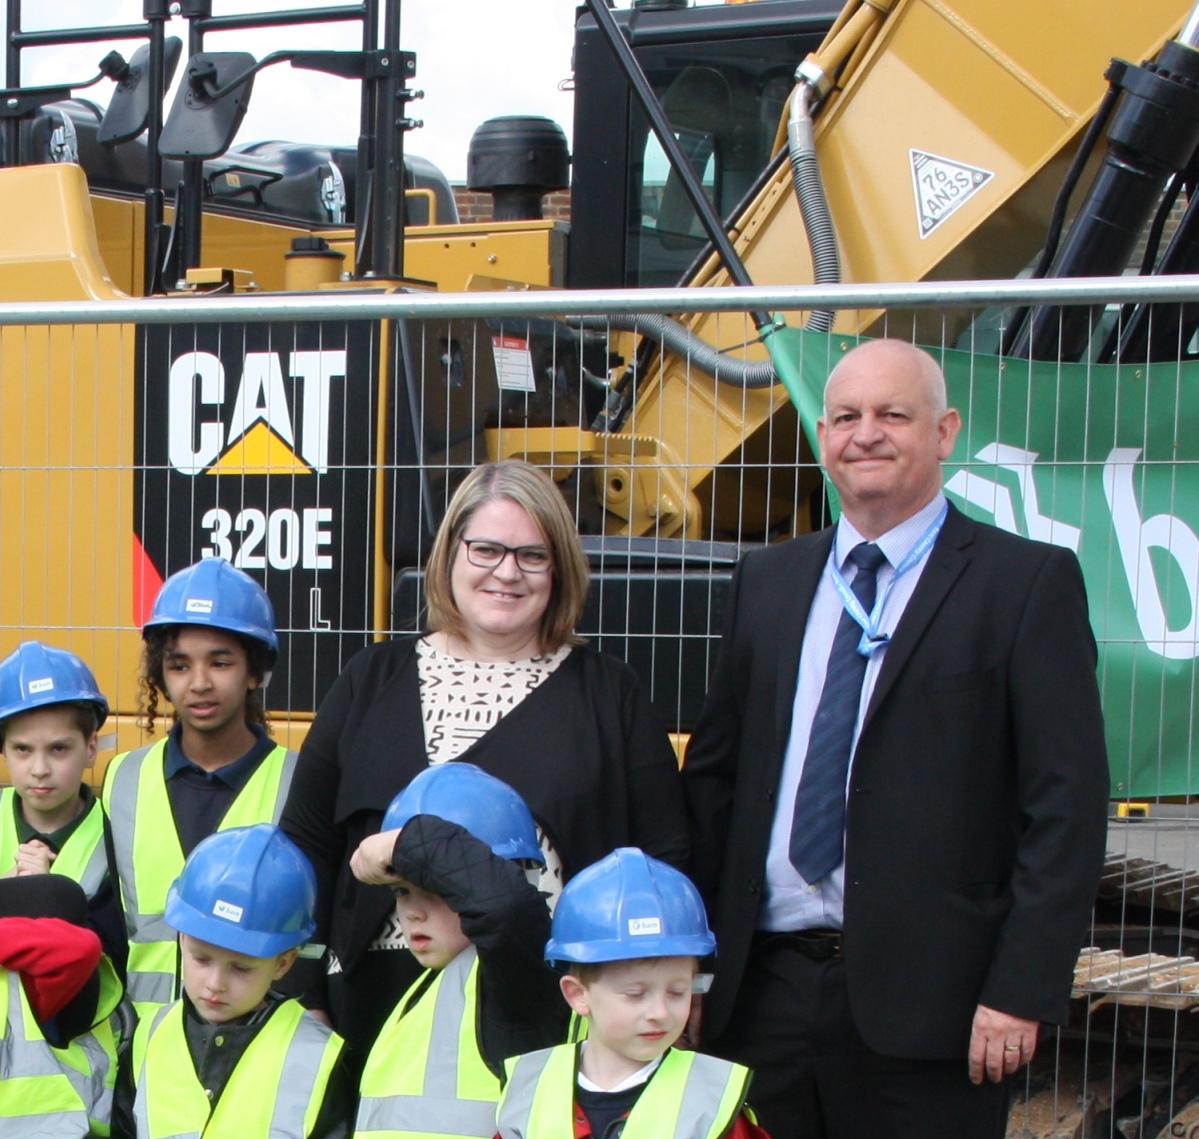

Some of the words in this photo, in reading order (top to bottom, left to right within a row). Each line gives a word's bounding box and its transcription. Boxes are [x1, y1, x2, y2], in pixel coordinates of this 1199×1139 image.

[922, 168, 947, 191] 76
[927, 172, 970, 215] AN3S
[168, 351, 347, 475] CAT
[201, 508, 333, 570] 320E
[310, 588, 331, 630] L
